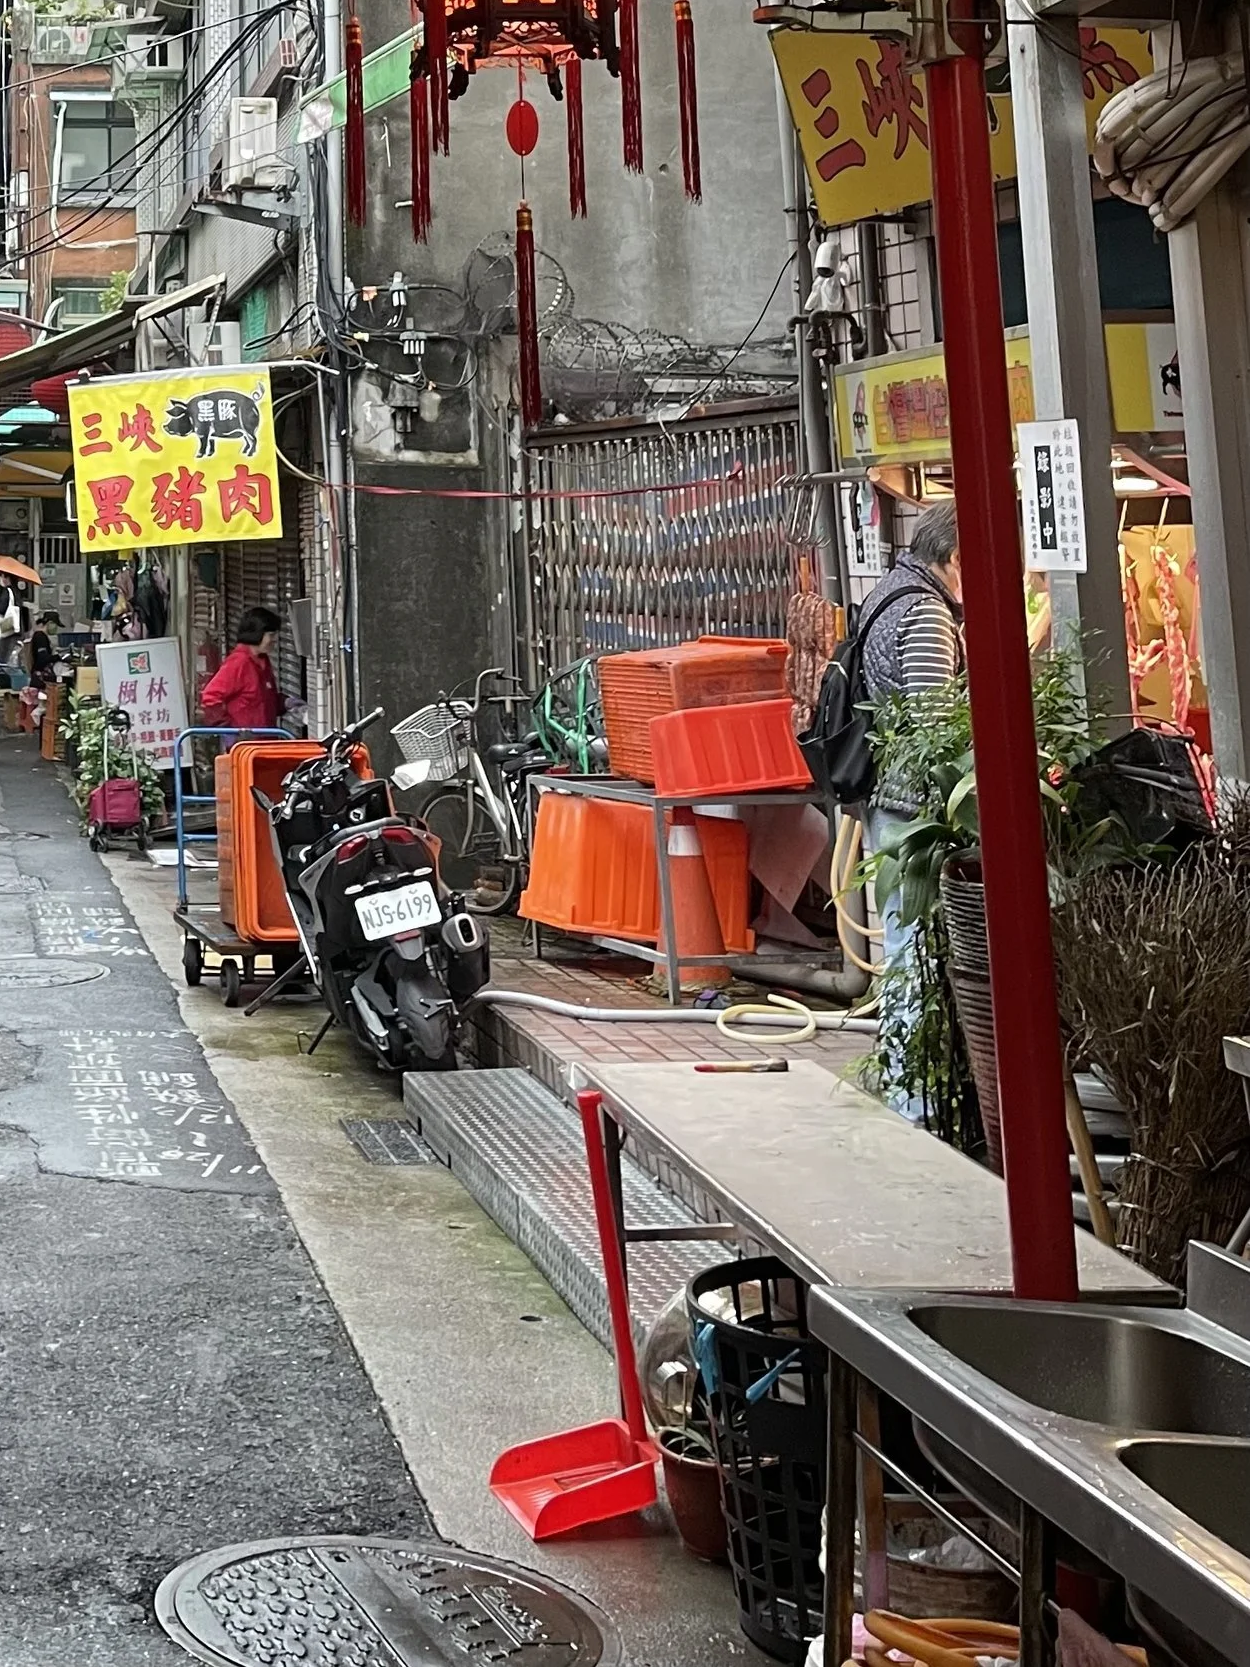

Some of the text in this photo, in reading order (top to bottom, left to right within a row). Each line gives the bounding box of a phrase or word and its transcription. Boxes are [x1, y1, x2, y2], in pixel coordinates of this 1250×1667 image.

[79, 402, 163, 457] 三峽
[197, 398, 238, 422] 黑豚
[87, 463, 273, 541] 黑豬肉
[361, 893, 432, 931] NJS-6199
